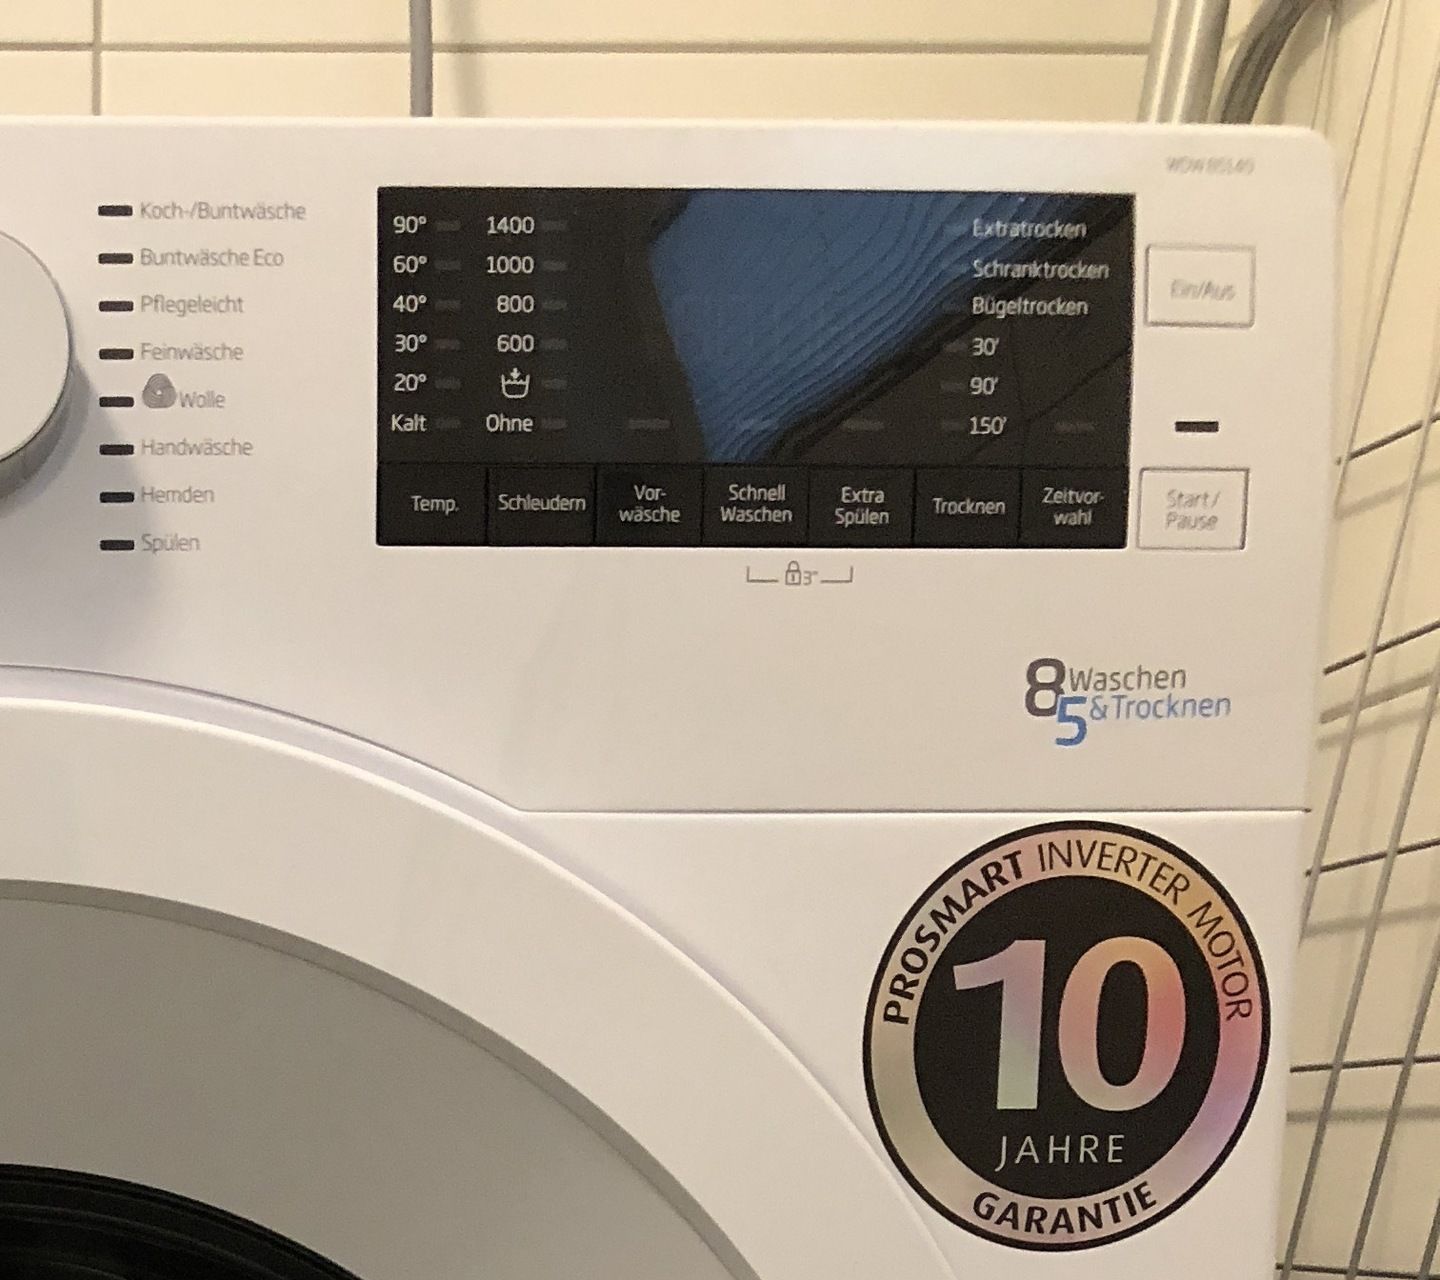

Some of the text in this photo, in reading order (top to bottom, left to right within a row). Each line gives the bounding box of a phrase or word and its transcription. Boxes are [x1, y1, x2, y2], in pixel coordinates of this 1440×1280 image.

[140, 201, 307, 220] Koch-/Buntwäsche
[393, 215, 427, 234] 90°
[487, 216, 535, 234] 1400
[973, 218, 1087, 238] Extratrocken
[140, 248, 285, 267] Buntwäsche Eco
[393, 255, 427, 274] 60°
[487, 255, 534, 274] 1000
[973, 259, 1110, 279] Schranktrocken
[140, 295, 245, 317] Pflegeleicht
[392, 294, 427, 313] 40°
[497, 294, 534, 313] 800
[972, 296, 1089, 319] Bügeltrocken
[140, 342, 245, 361] Feinwäsche
[394, 333, 428, 353] 30°
[497, 334, 534, 353] 600
[394, 373, 427, 392] 20°
[179, 390, 226, 409] Wolle
[391, 413, 427, 432] Kalt
[486, 413, 534, 432] Ohne
[140, 437, 254, 457] Handwäsche
[140, 486, 215, 504] Hemden
[498, 493, 586, 512] Schleudern
[633, 484, 667, 502] Vor-
[728, 484, 786, 502] Schnell
[841, 486, 885, 503] Extra
[1043, 487, 1105, 504] Zeitvor-
[1166, 488, 1221, 510] Start/
[411, 494, 460, 516] Temp.
[619, 506, 681, 523] wäsche
[720, 506, 792, 523] Waschen
[933, 497, 1006, 515] Trocknen
[834, 506, 890, 528] Spülen
[1053, 508, 1093, 526] wahl
[1165, 512, 1219, 531] Pause
[141, 533, 200, 555] Spülen
[1025, 658, 1187, 717] 8 Waschen
[1056, 695, 1087, 746] 5
[883, 839, 1252, 1025] PROSMART INVERTER MOTOR
[953, 935, 1186, 1112] 10
[995, 1134, 1125, 1172] JAHRE
[972, 1181, 1157, 1234] GARANTIE
